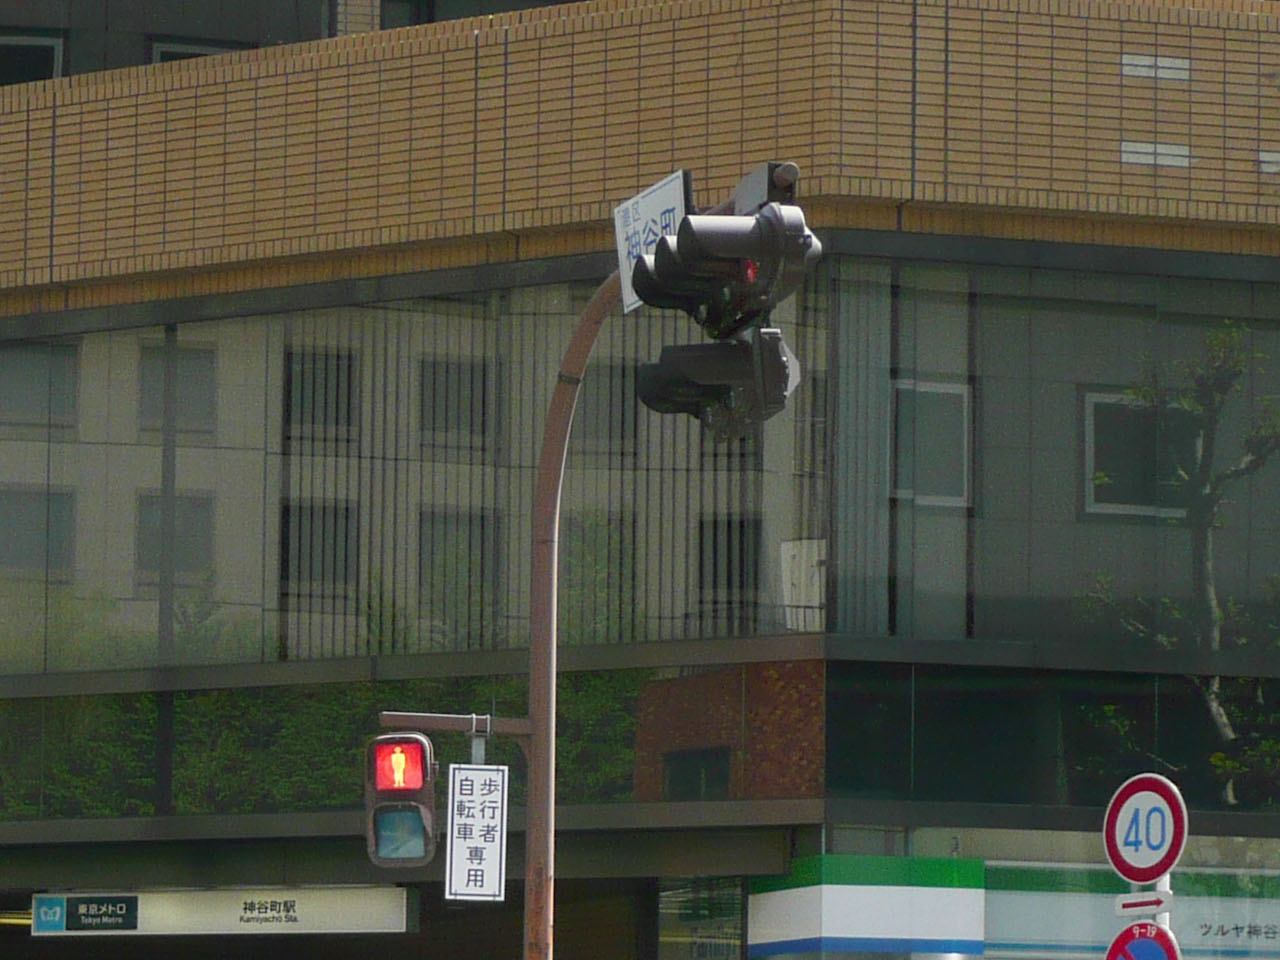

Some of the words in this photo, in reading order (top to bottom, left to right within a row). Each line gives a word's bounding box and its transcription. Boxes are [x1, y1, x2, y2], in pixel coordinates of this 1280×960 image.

[455, 776, 476, 842] 自転車
[479, 777, 500, 843] 歩行者
[1123, 806, 1167, 853] 40
[465, 846, 487, 888] 専用
[78, 903, 126, 915] 東京メトロ
[243, 900, 297, 914] 神谷町駅
[1132, 925, 1158, 938] 9-19
